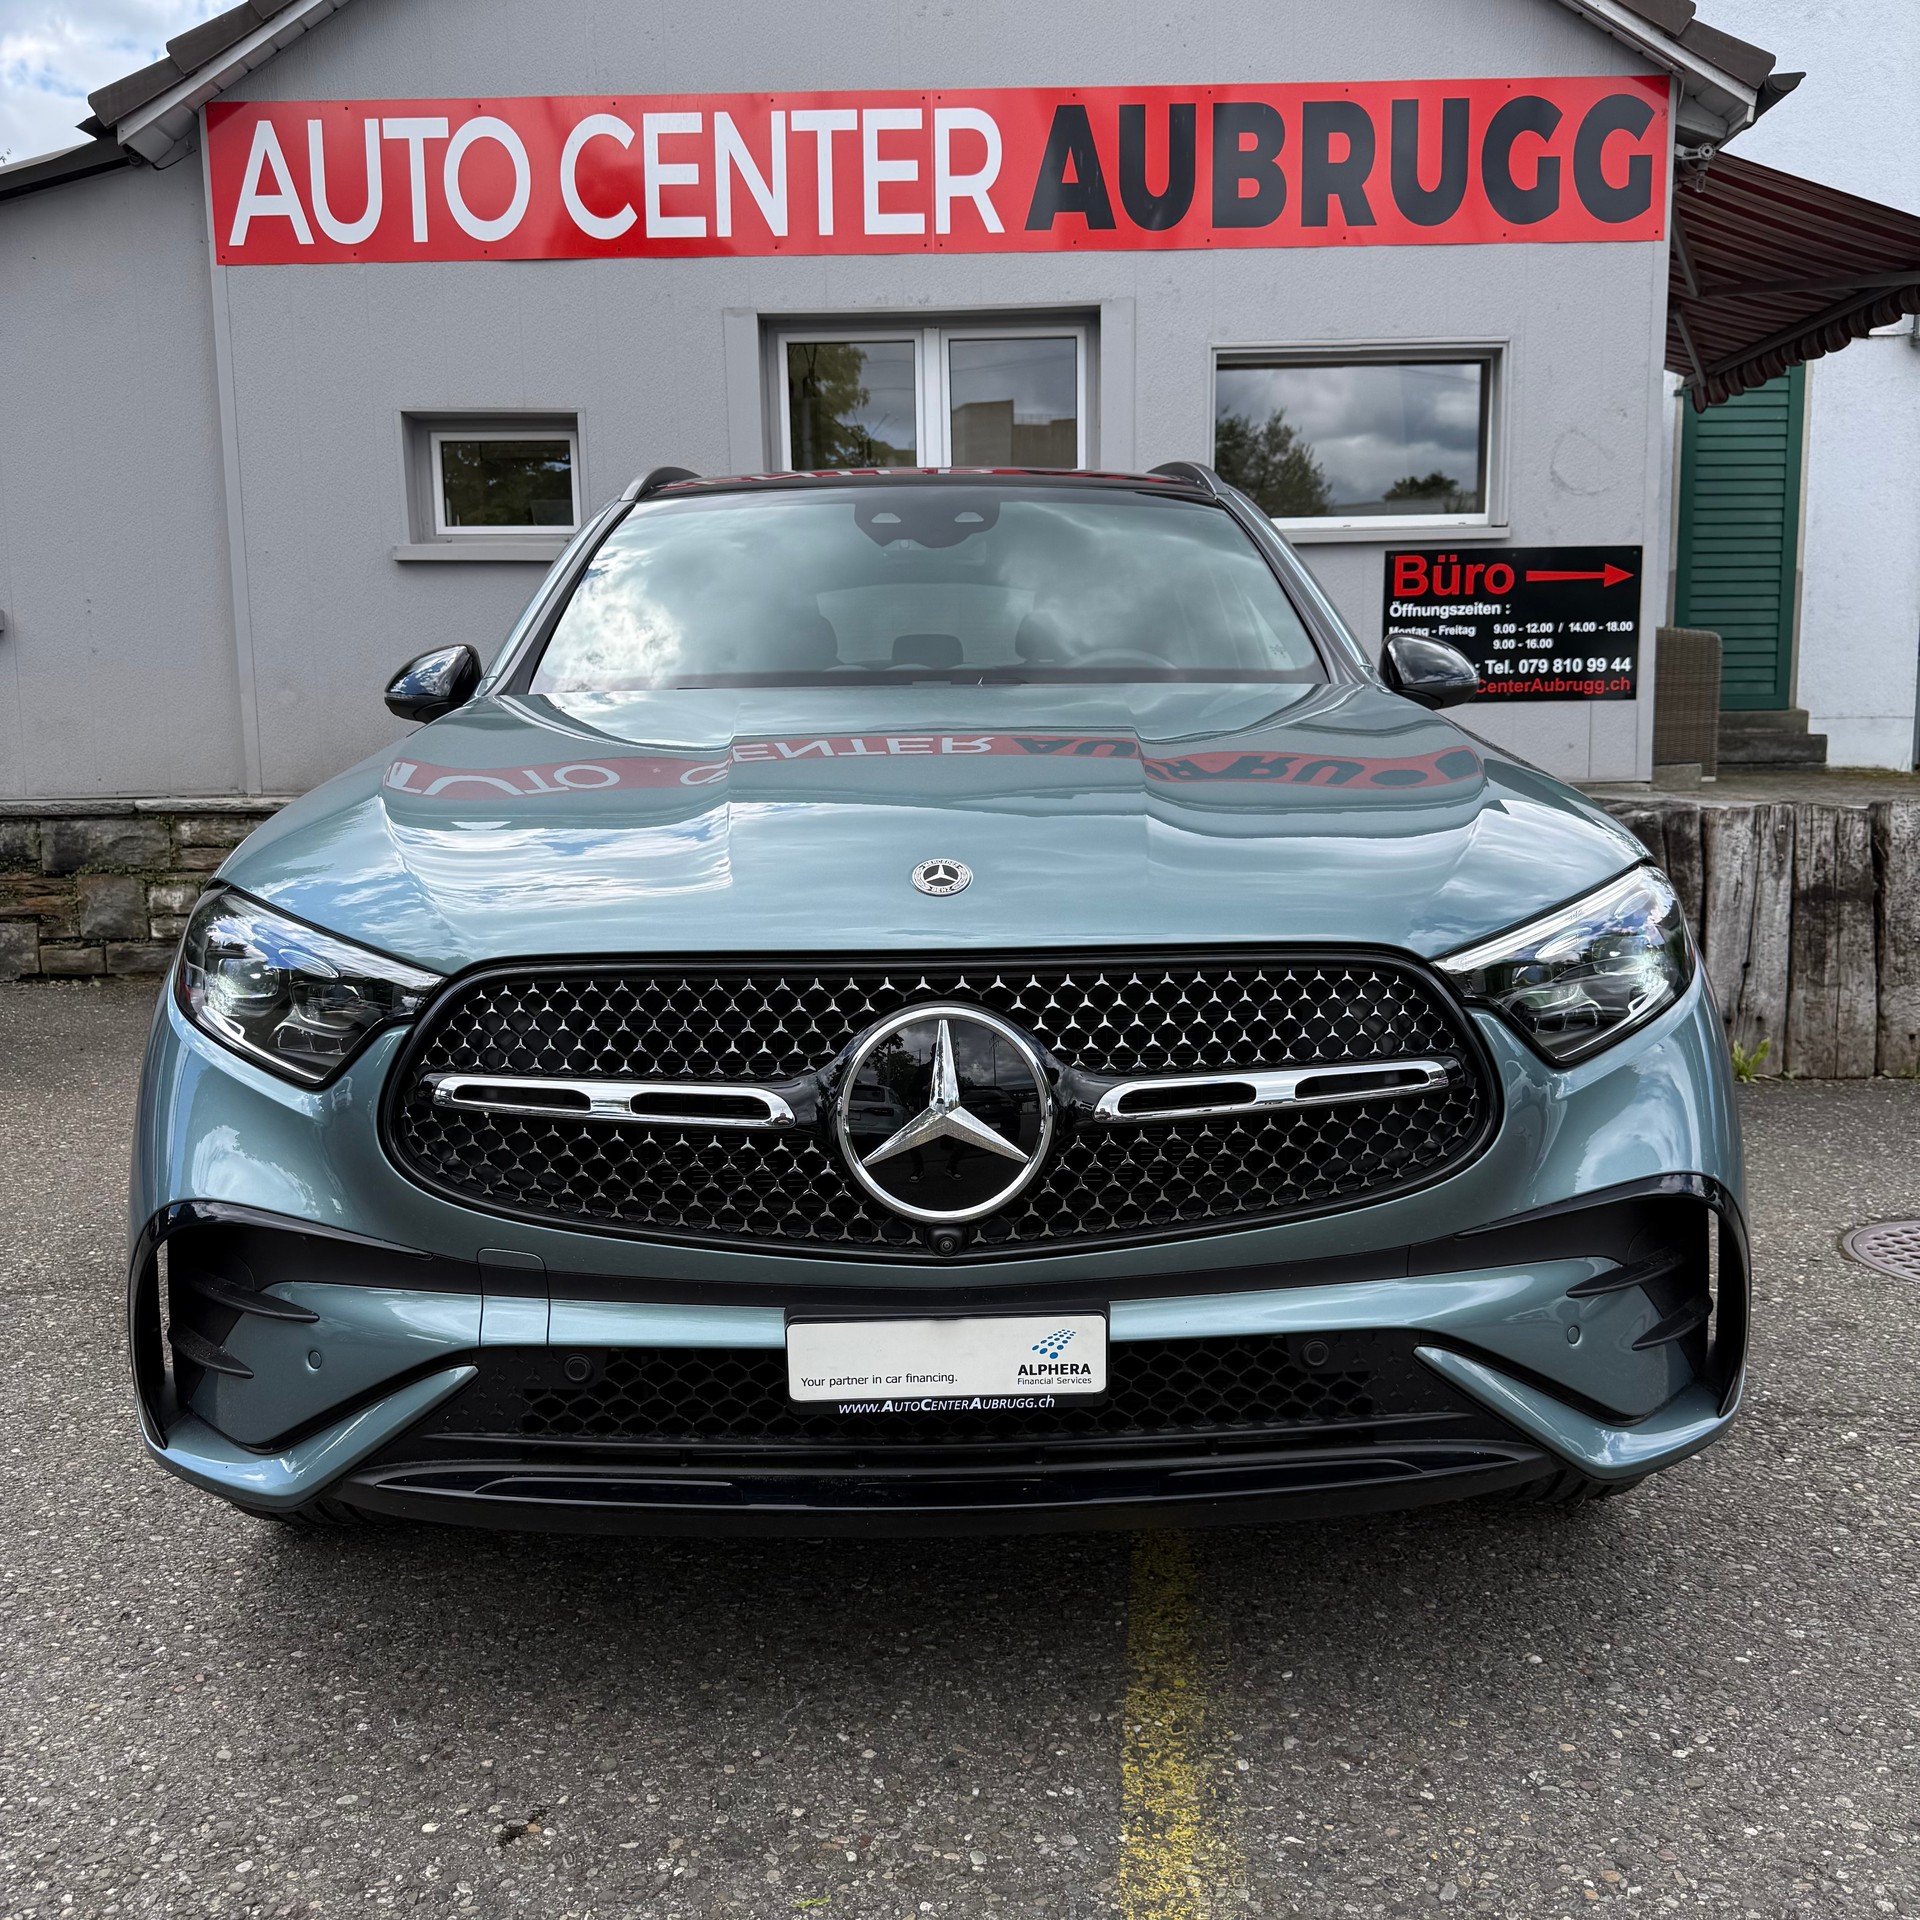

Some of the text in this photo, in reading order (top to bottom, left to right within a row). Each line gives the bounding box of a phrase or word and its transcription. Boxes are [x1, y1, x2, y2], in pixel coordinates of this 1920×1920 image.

[229, 94, 1656, 246] AUTO CENTER AUBRUGG
[1393, 554, 1515, 597] Büro
[1389, 601, 1502, 619] Öffnungszeiten
[1438, 624, 1477, 637] Freitag
[1493, 623, 1517, 634] 9.00
[1525, 622, 1554, 633] 12.00
[1568, 621, 1597, 633] 14.00
[1605, 620, 1634, 632] 18.00
[1492, 638, 1516, 650] 9.00
[1525, 638, 1554, 650] 16.00
[1484, 659, 1515, 675] Tel.
[1518, 658, 1549, 674] 079
[1552, 657, 1583, 674] 810
[1586, 657, 1608, 673] 99
[1610, 656, 1632, 672] 44
[1476, 676, 1631, 695] CenterAubrugg.ch
[1017, 1363, 1092, 1376] ALPHERA
[801, 1372, 958, 1388] Your partner in car financing.
[1017, 1376, 1092, 1385] Financial Services
